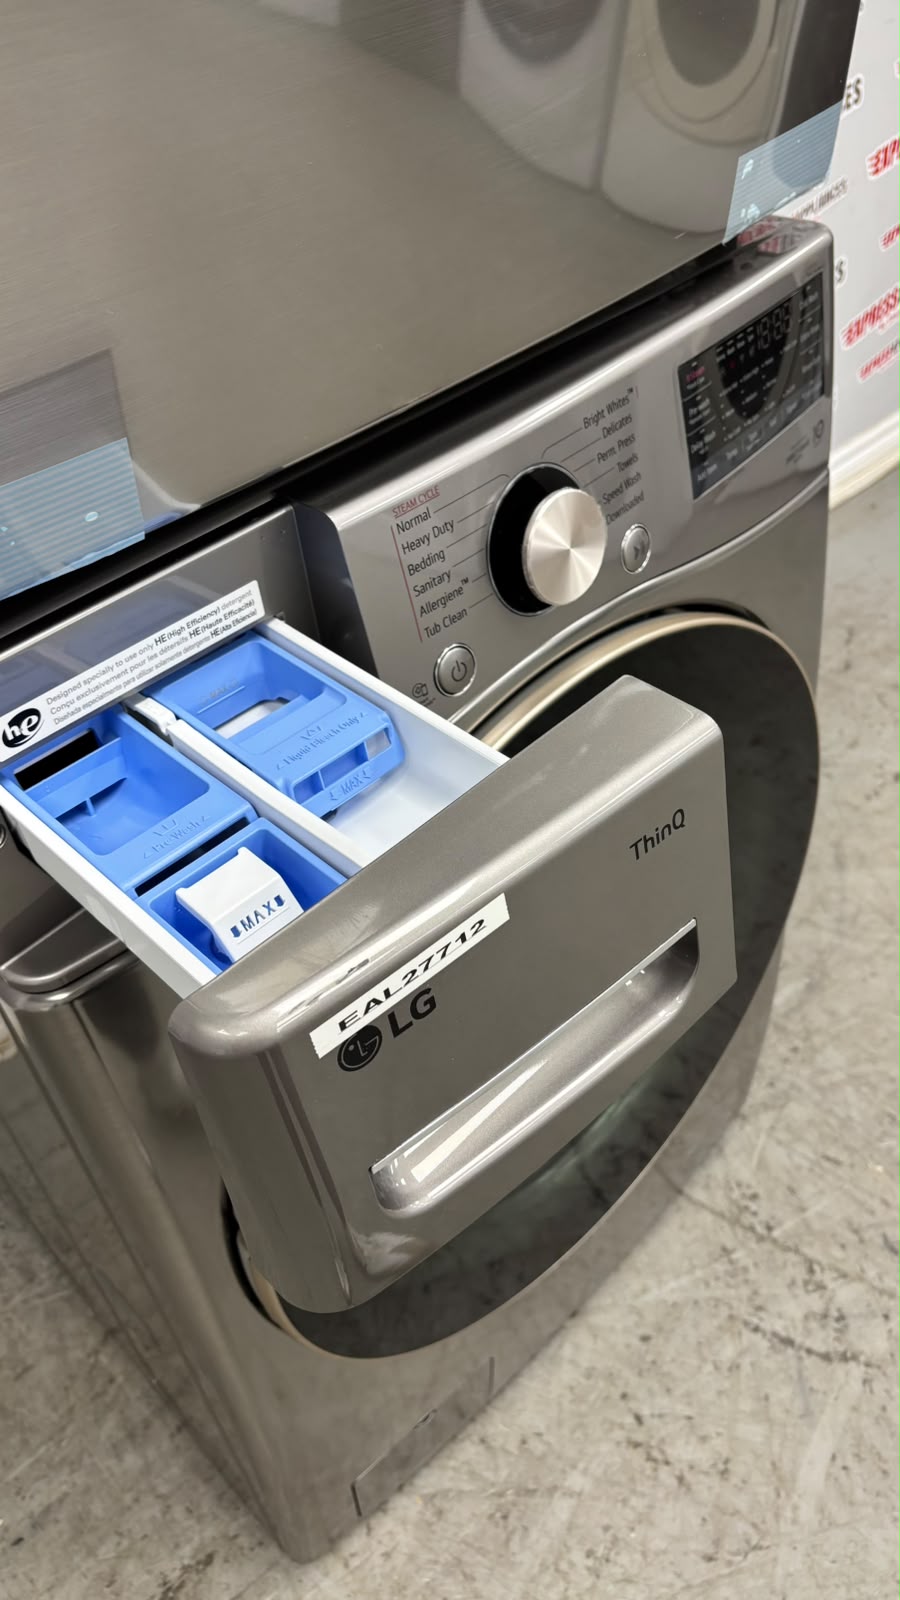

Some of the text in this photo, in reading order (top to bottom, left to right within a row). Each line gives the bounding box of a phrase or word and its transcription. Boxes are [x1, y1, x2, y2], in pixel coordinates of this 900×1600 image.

[583, 409, 606, 429] Bright
[602, 414, 632, 439] Delicates
[617, 433, 636, 450] Press
[617, 453, 639, 472] Towels
[392, 485, 440, 518] STEAM CYCLE
[602, 472, 641, 504] Speed Wash
[396, 507, 432, 535] Normal
[605, 490, 645, 525] Downloaded
[401, 519, 455, 555] Heavy Duty
[407, 550, 446, 577] Bedding
[413, 570, 451, 598] Sanitary
[424, 608, 468, 639] Tub Clean
[46, 682, 82, 706] Designed
[82, 664, 114, 686] specially
[115, 660, 124, 669] to
[124, 652, 137, 663] use
[138, 642, 155, 656] only
[186, 606, 221, 631] Efficiency)
[50, 698, 76, 716] Conçu
[76, 668, 129, 701] exclusivement
[129, 660, 146, 673] pour
[147, 652, 159, 663] les
[223, 599, 256, 621] Efficacité)
[82, 684, 123, 711] especialmente
[122, 677, 136, 690] para
[283, 745, 311, 765] Liquid
[338, 716, 360, 731] Only
[340, 774, 364, 796] MAX
[629, 808, 686, 861] ThinQ
[239, 900, 276, 932] MAX
[337, 918, 487, 1033] EAL27712
[387, 987, 437, 1038] LG
